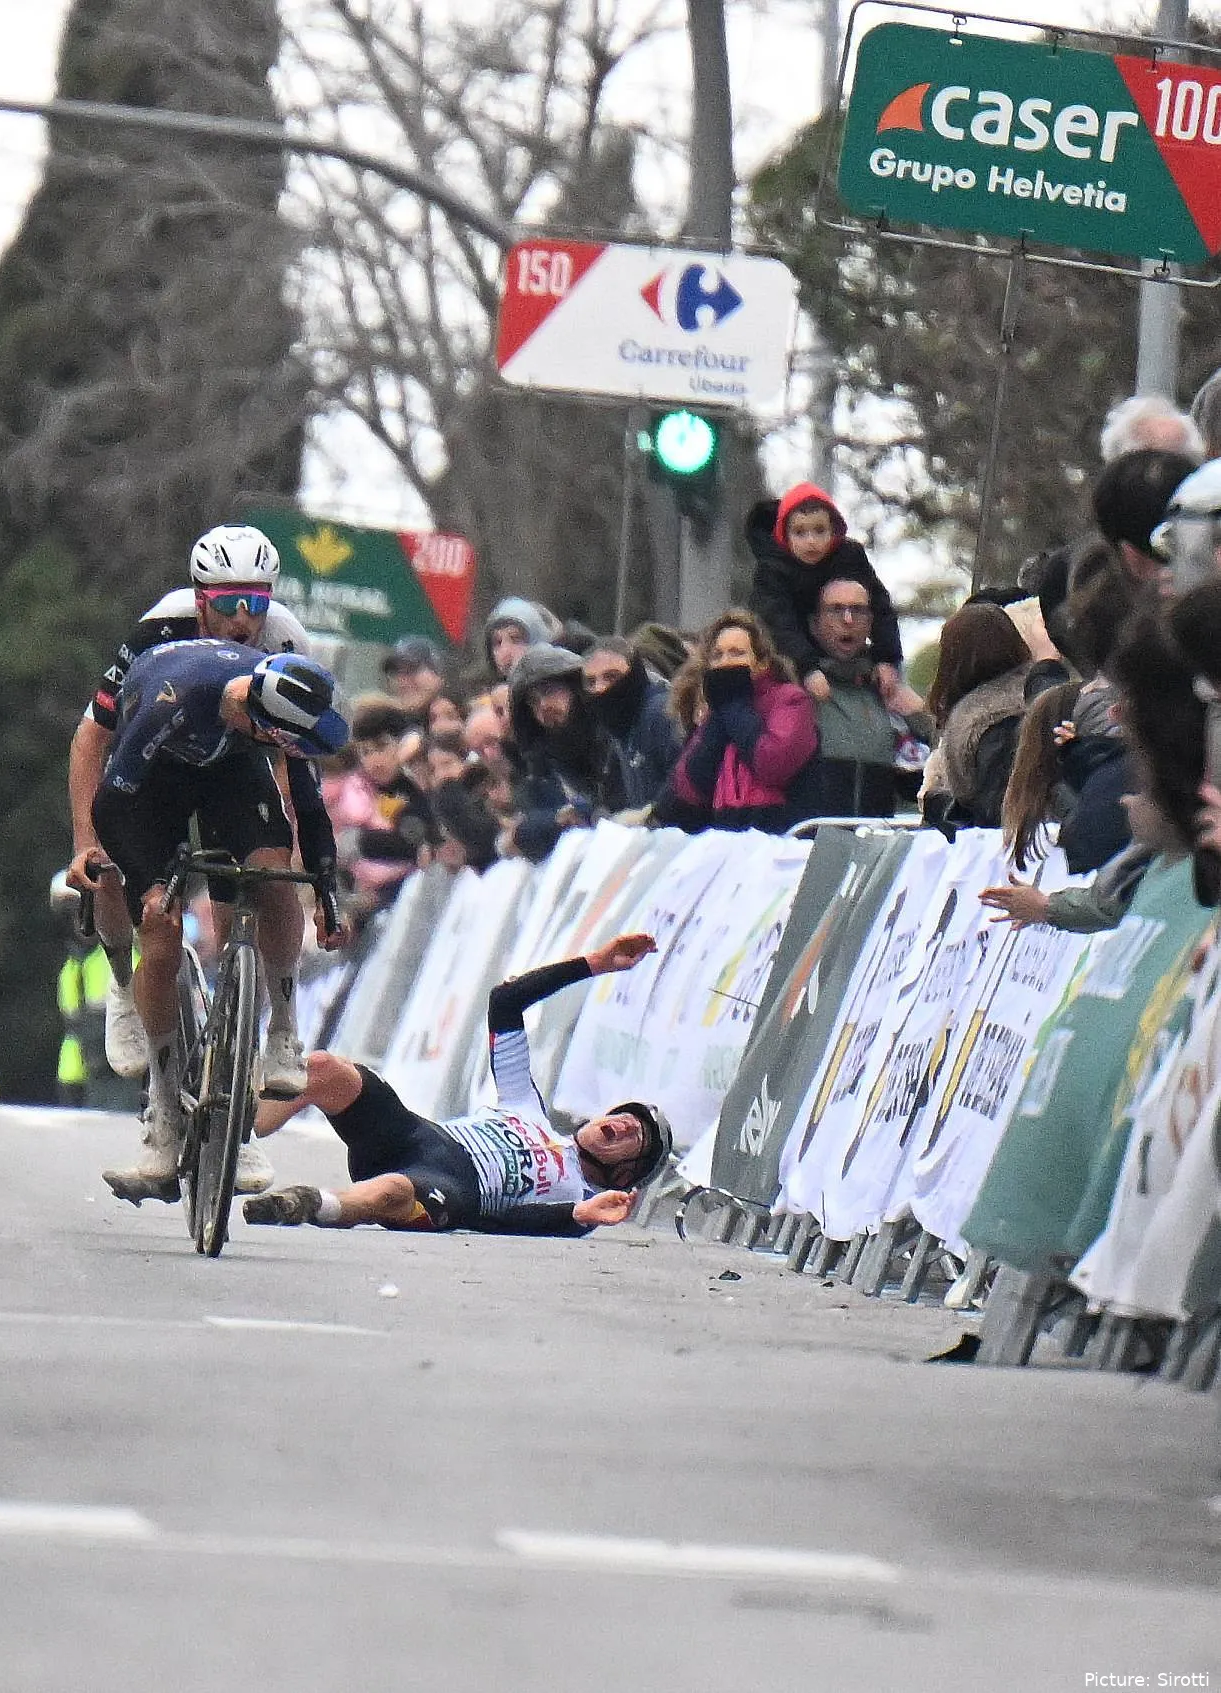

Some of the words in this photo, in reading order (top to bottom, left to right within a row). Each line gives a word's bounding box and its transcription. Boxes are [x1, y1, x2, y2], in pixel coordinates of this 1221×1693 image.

[931, 85, 1139, 163] caser
[869, 148, 976, 192] Grupo
[987, 165, 1127, 214] Helvetia
[517, 250, 572, 296] 150
[617, 339, 751, 372] Carrefour
[533, 1149, 552, 1197] Bull
